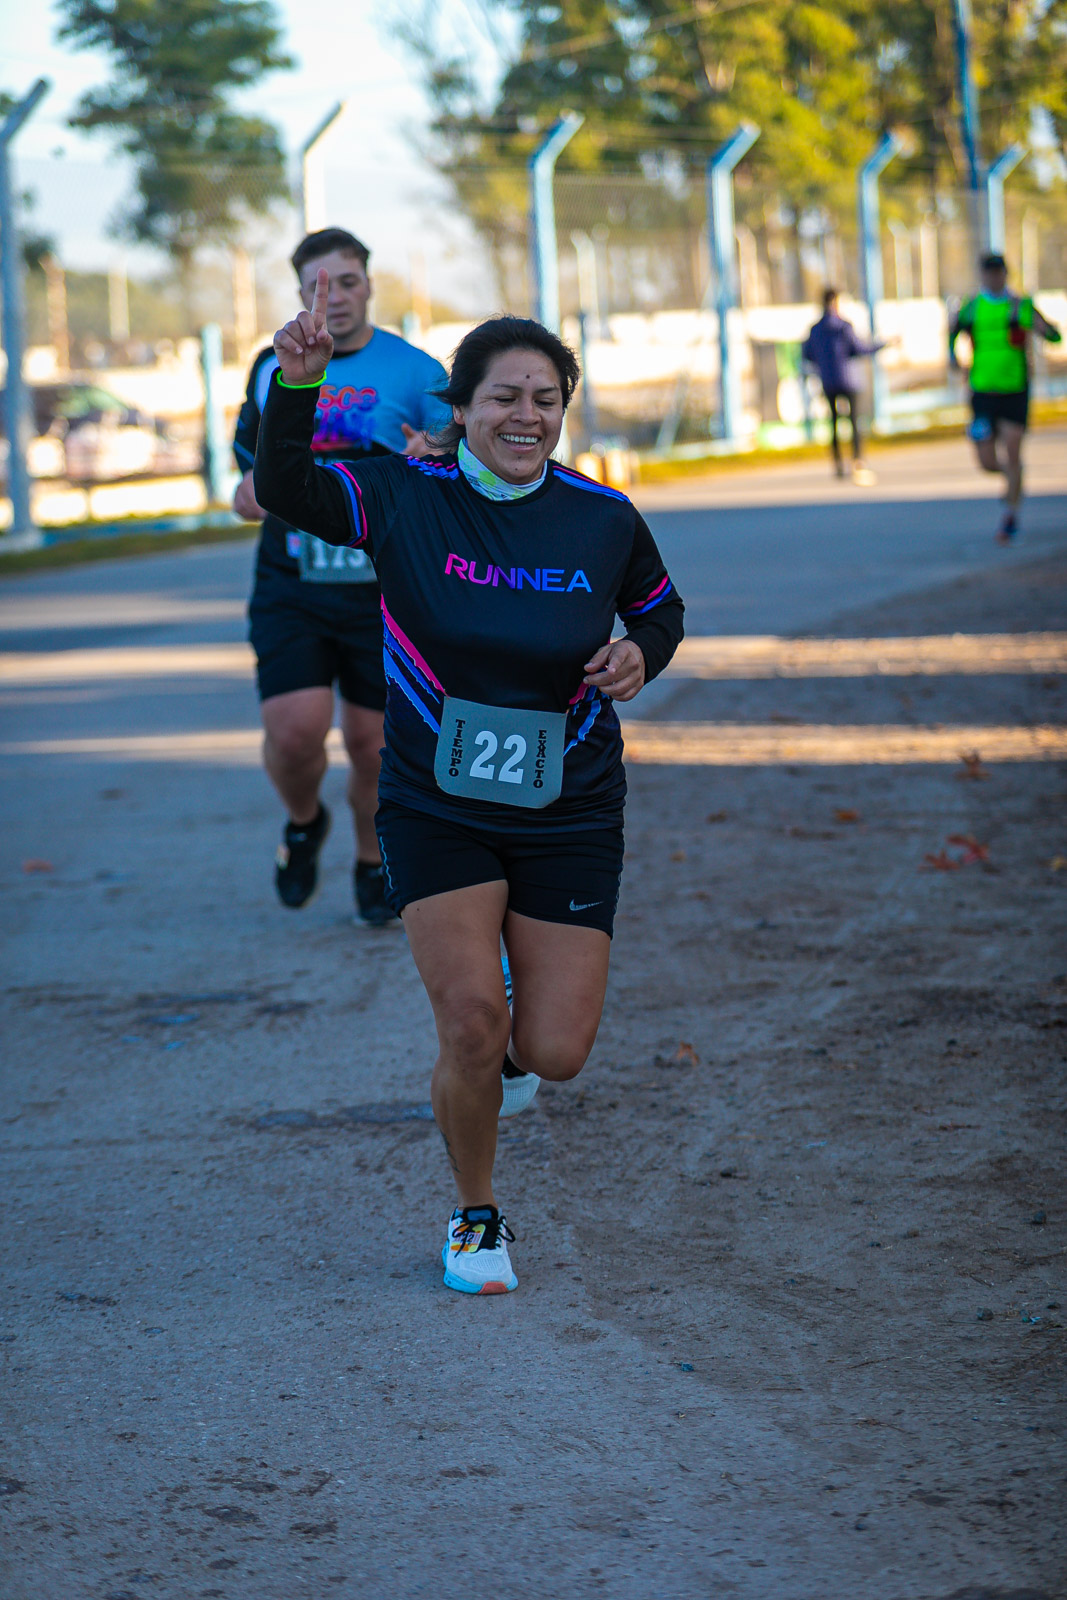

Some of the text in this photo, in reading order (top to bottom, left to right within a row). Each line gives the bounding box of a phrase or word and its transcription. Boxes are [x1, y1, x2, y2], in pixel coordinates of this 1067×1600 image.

[445, 553, 592, 592] RUNNEA
[449, 719, 465, 777] TIEMPO
[470, 730, 527, 785] 22
[533, 730, 547, 788] EXACTO
